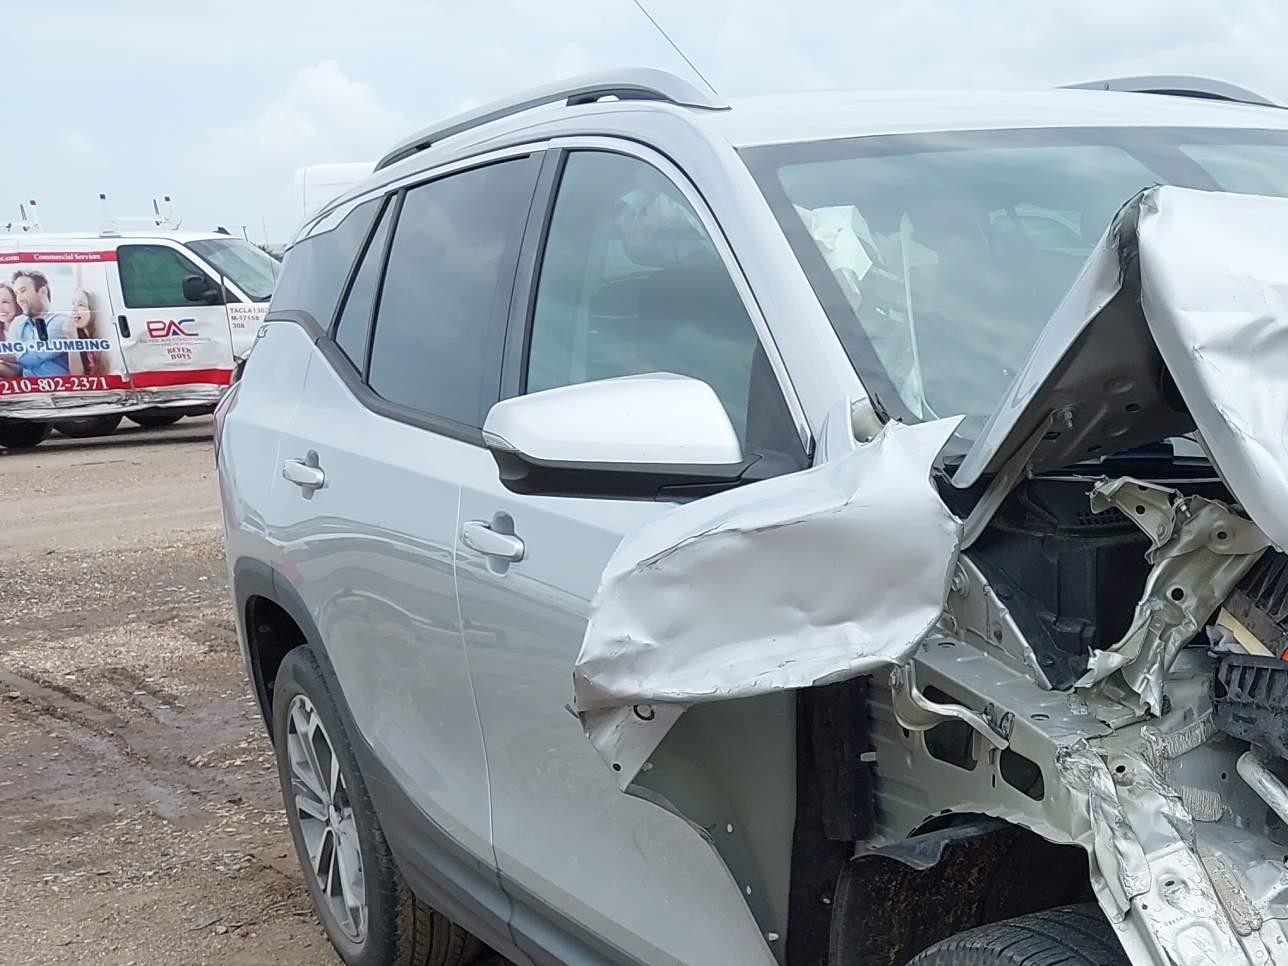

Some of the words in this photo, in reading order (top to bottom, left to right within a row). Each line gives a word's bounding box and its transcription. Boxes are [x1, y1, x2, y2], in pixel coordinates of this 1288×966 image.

[33, 253, 74, 261] Commercial
[36, 339, 110, 352] PLUMBING
[1, 376, 110, 395] 210-802-2371
